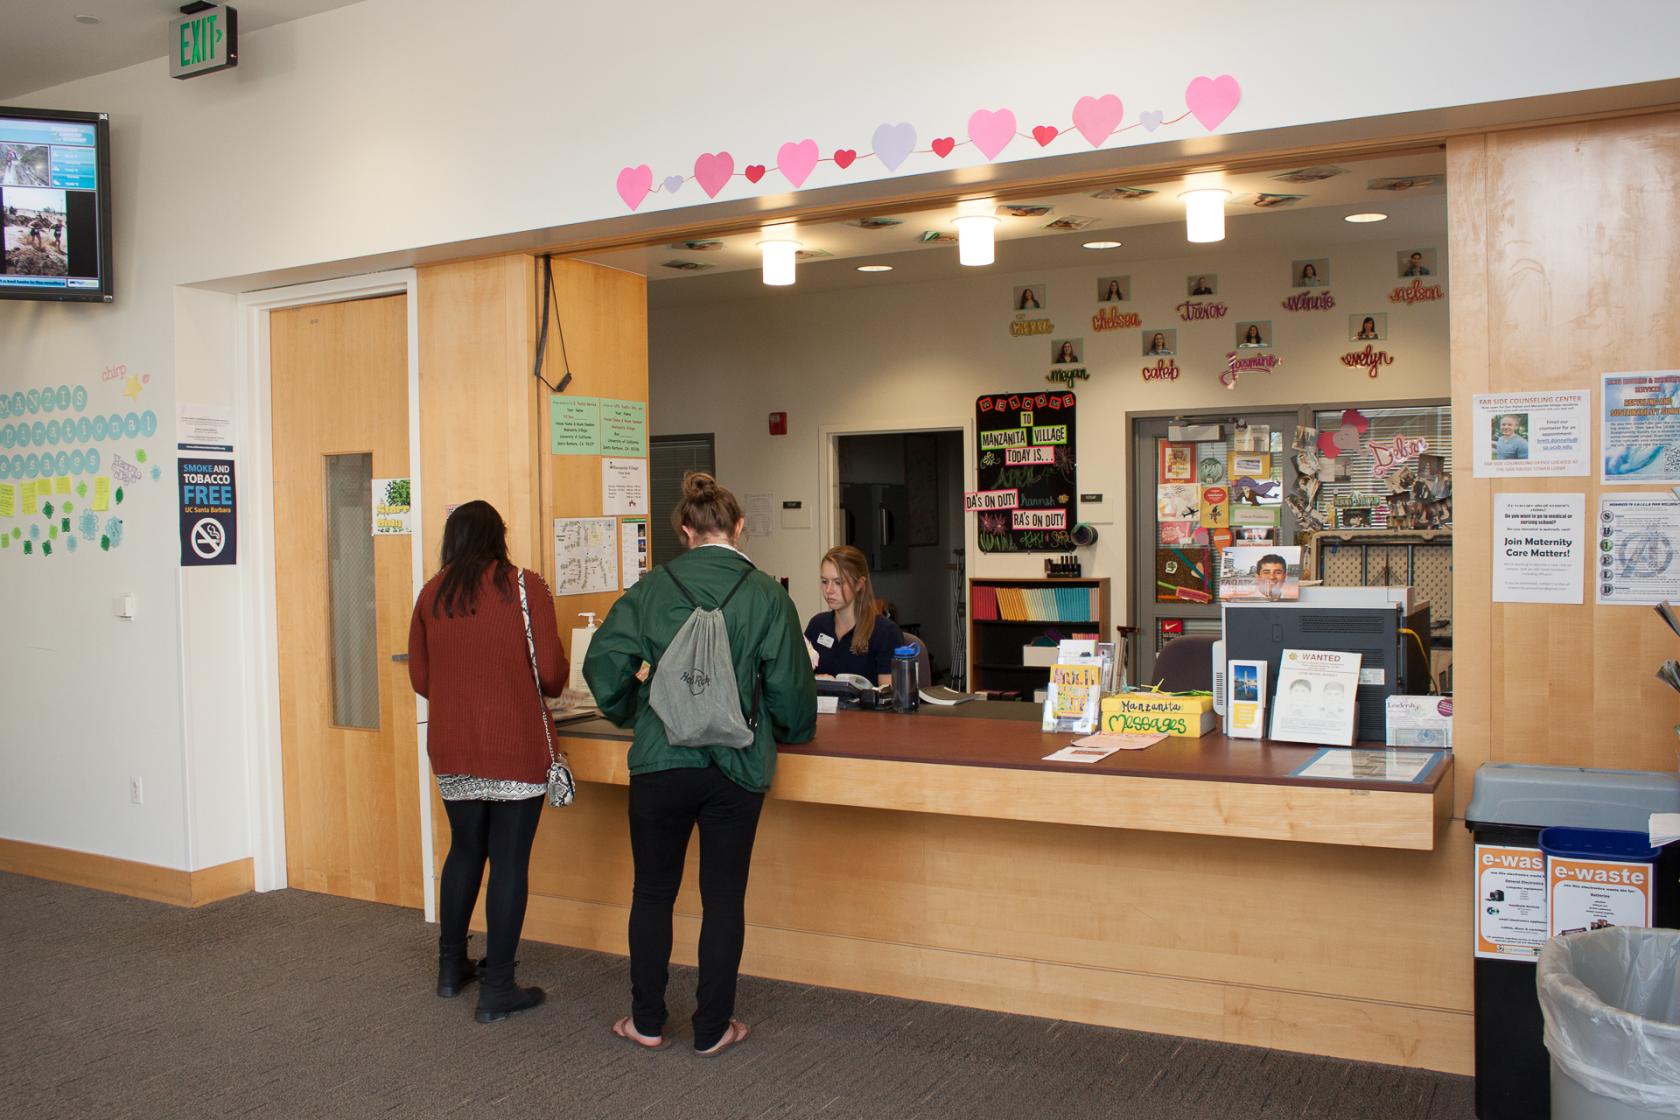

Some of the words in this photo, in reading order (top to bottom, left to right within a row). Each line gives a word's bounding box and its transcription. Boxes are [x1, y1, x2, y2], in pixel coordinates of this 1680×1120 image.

[180, 15, 217, 67] EXIT
[1388, 280, 1444, 303] nelson
[1282, 291, 1336, 311] winnie
[1092, 305, 1142, 332] chelsea
[1177, 301, 1228, 321] trevor
[1340, 344, 1394, 378] evelyn
[1046, 368, 1090, 388] megan
[1142, 359, 1180, 382] caleb
[980, 394, 1073, 411] WELCOME
[1023, 413, 1032, 424] TO
[982, 431, 1026, 447] MANZANITA
[1034, 427, 1065, 442] VILLAGE
[1008, 449, 1030, 462] TODAY
[184, 464, 213, 472] SMOKE
[213, 465, 230, 473] AND
[184, 474, 230, 484] TOBACCO
[184, 485, 232, 505] FREE
[985, 495, 995, 508] ON
[998, 493, 1016, 507] DUTY
[1032, 514, 1043, 527] ON
[1046, 513, 1065, 527] DUTY
[1604, 512, 1611, 520] S
[1504, 538, 1522, 546] Join
[1525, 538, 1572, 547] Maternity
[1506, 549, 1528, 557] Care
[1531, 549, 1570, 557] Matters!
[1603, 571, 1611, 579] L
[1604, 586, 1611, 594] D
[1302, 653, 1341, 662] WANTED
[1121, 701, 1181, 713] Manzanita
[1109, 714, 1187, 734] Messages
[1555, 866, 1644, 885] e-waste
